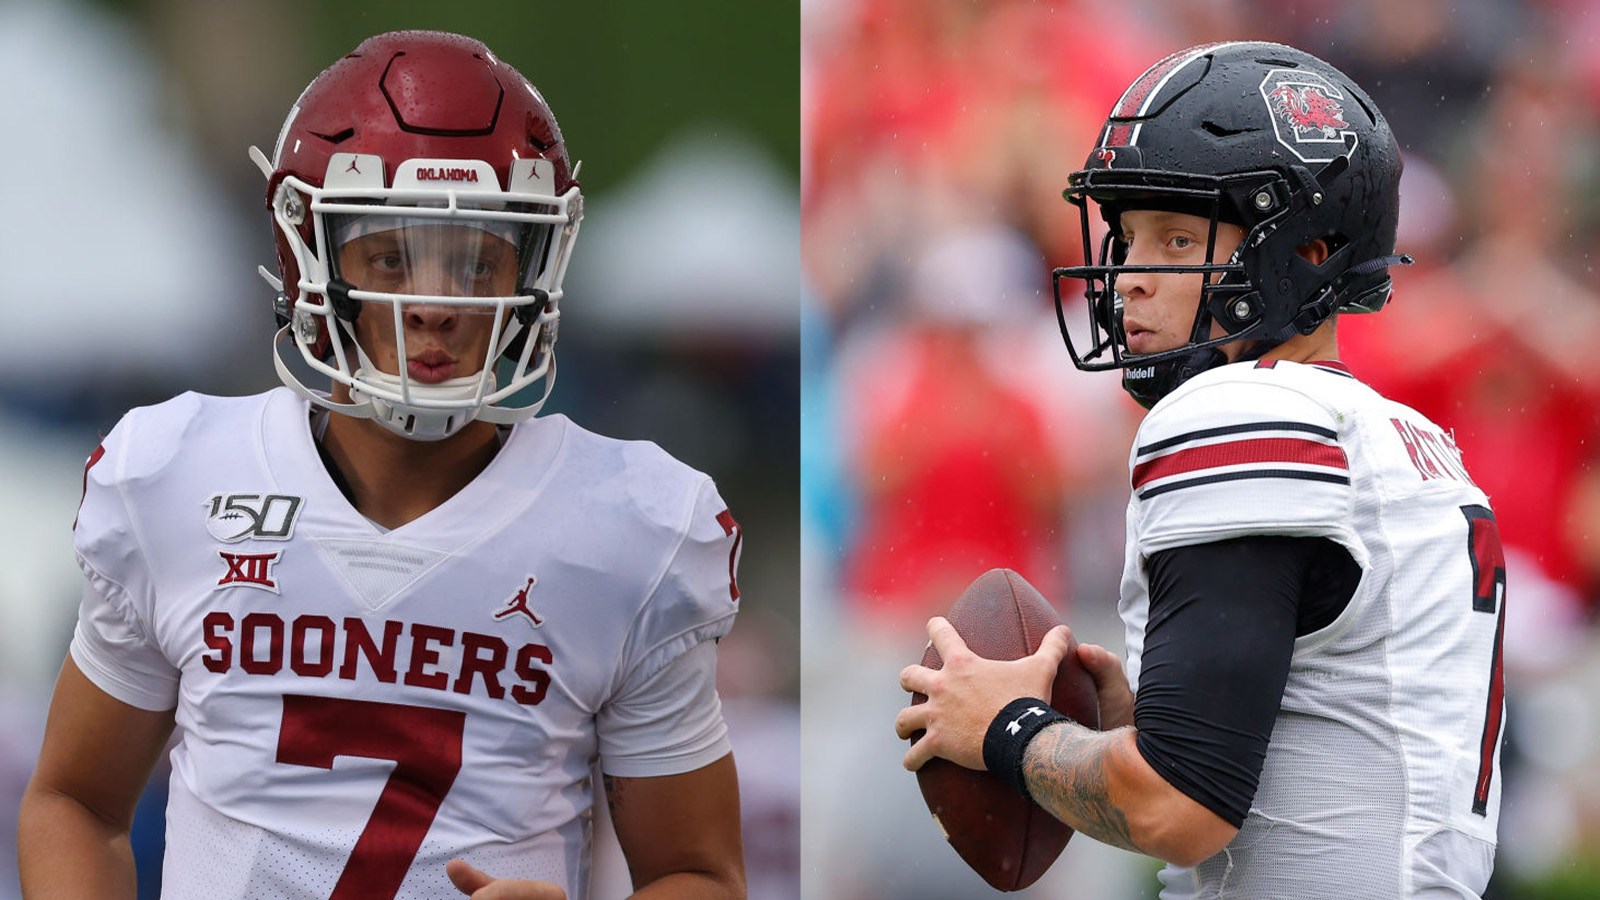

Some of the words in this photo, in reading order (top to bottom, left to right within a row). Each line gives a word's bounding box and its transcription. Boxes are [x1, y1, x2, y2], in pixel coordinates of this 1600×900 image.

[416, 167, 478, 182] OKLAHOMA
[210, 494, 301, 540] 150
[218, 551, 278, 588] XII
[202, 611, 553, 706] SOONERS
[1459, 503, 1506, 817] 7
[275, 693, 467, 900] 7
